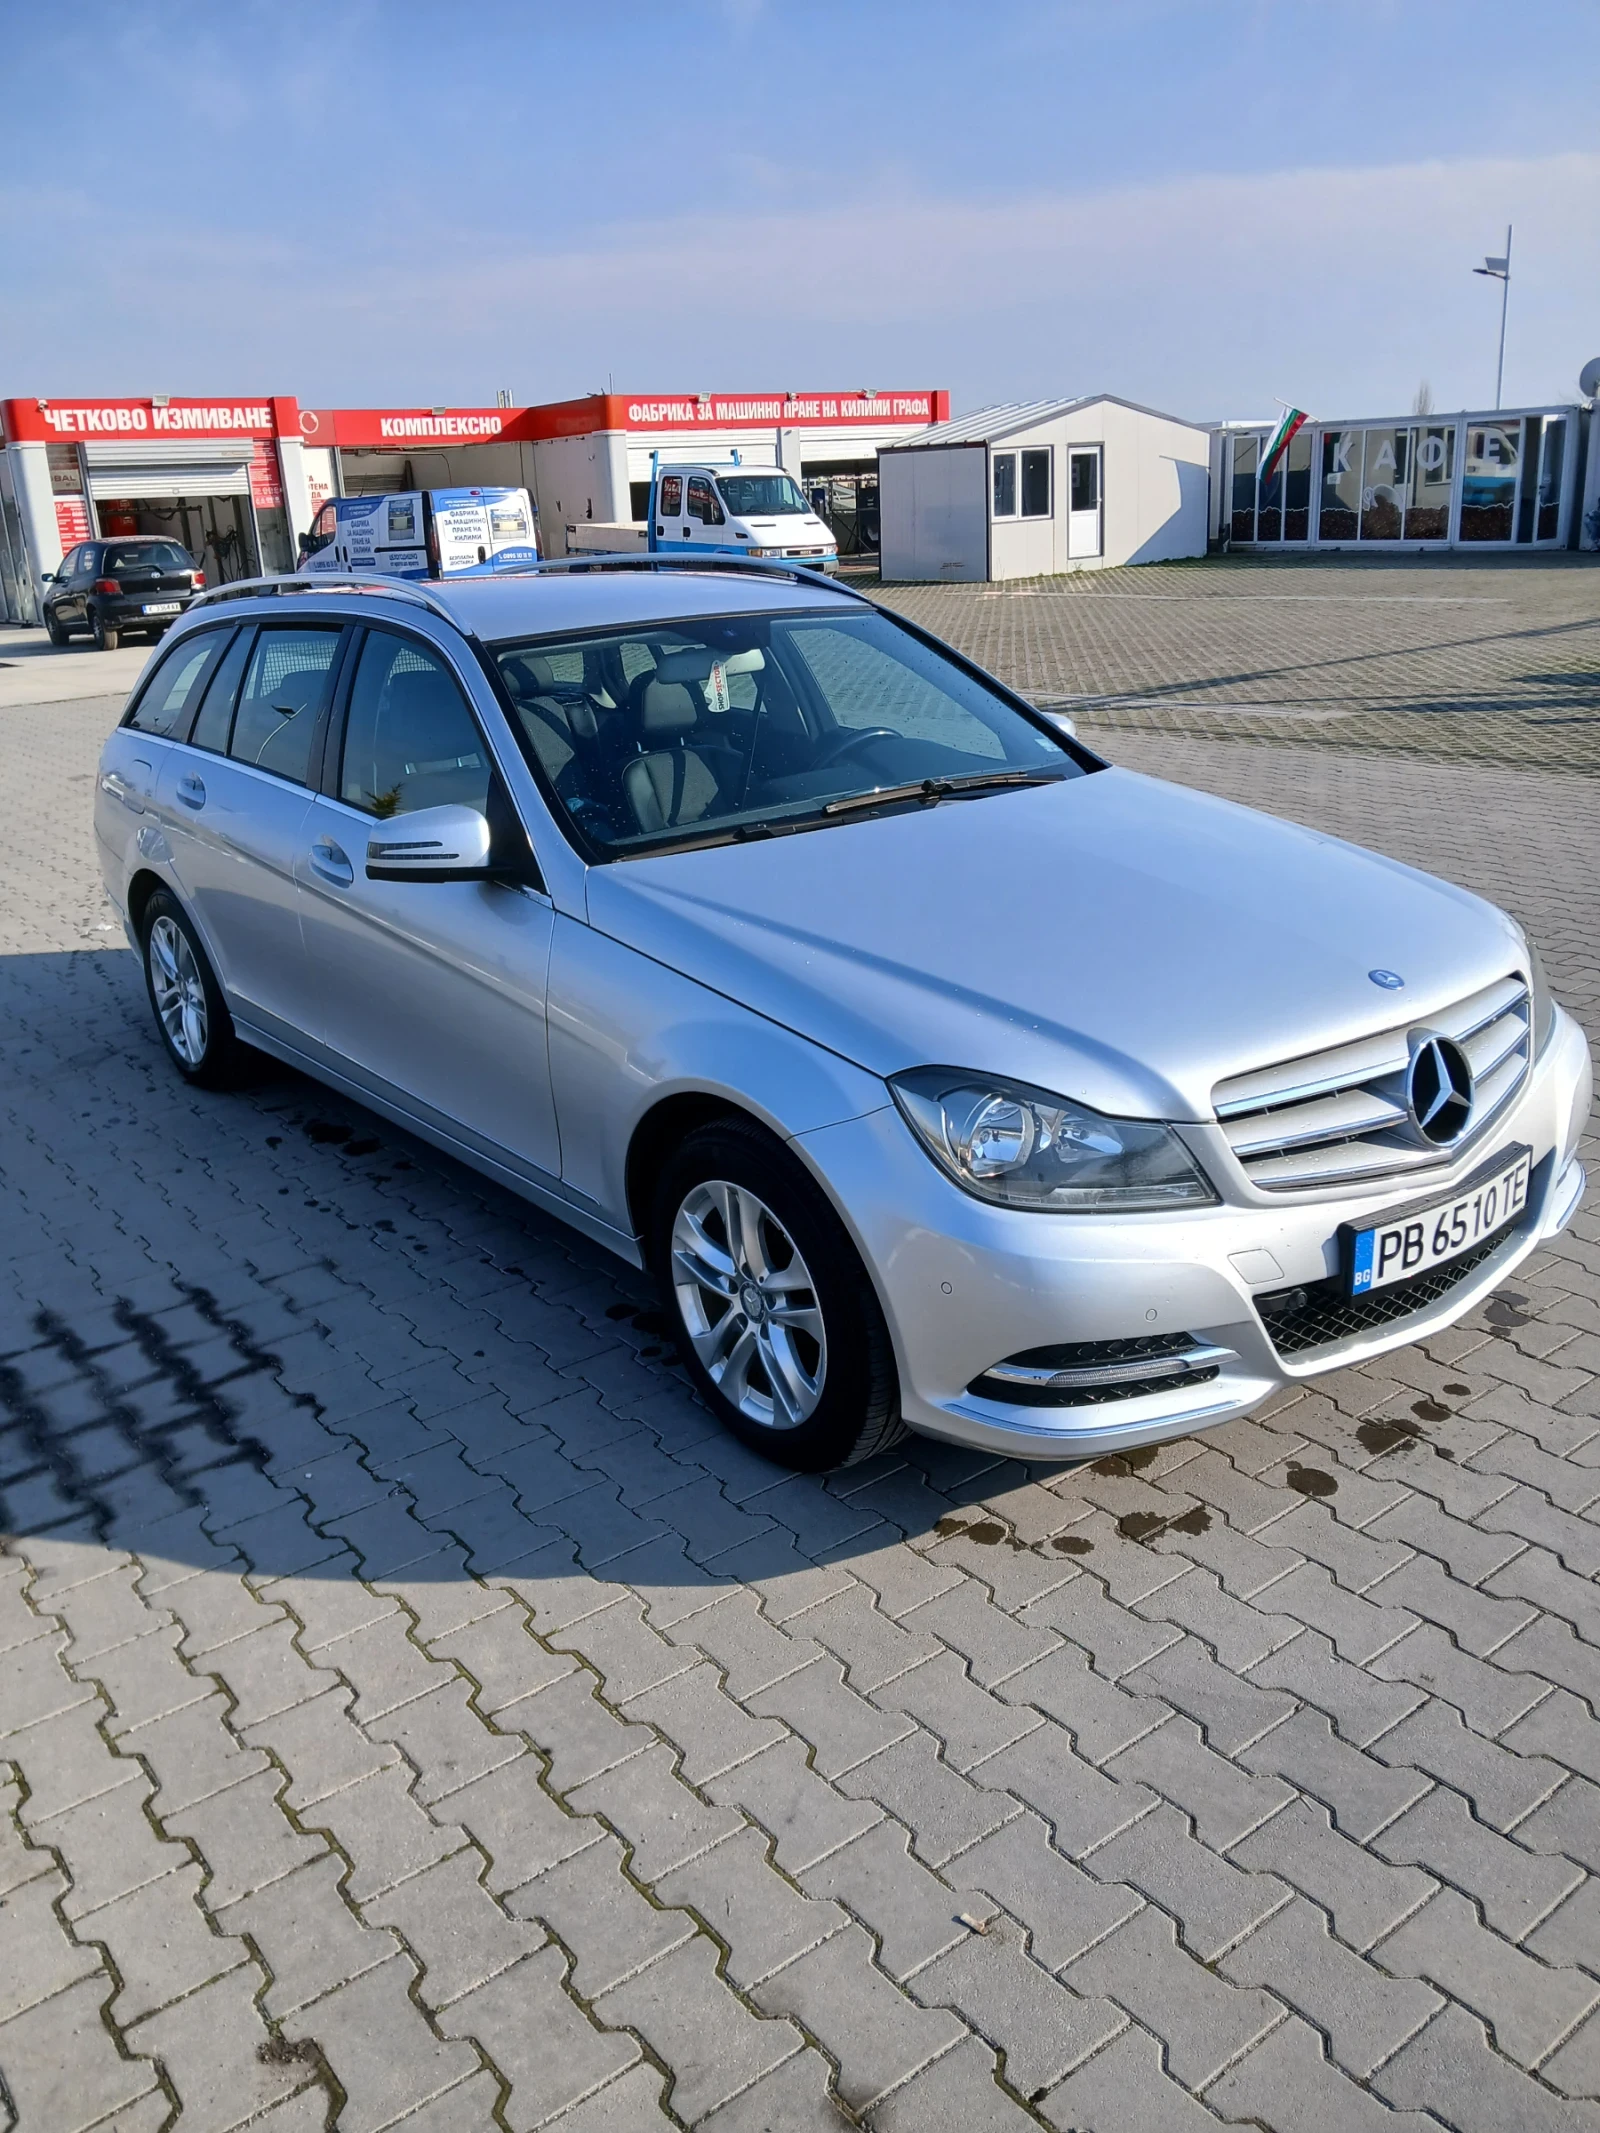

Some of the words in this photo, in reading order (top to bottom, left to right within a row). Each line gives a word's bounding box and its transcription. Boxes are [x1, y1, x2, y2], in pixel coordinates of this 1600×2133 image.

[44, 408, 147, 432] ЧЕТКОВО
[153, 406, 273, 430] ИЗМИВАНЕ
[628, 402, 694, 422] ФАБРИКА
[697, 402, 714, 421] ЗА
[716, 401, 781, 420] МАШИННО
[783, 400, 820, 418] ПРАНЕ
[822, 400, 838, 418] НА
[840, 399, 891, 417] КИЛИМИ
[893, 398, 929, 416] ГРАФА
[380, 416, 502, 437] КОМПЛЕКСНО
[308, 483, 328, 491] ТЕНА
[350, 520, 370, 528] ФАБРИКА
[453, 517, 486, 525] МАШИННО
[1377, 1222, 1424, 1279] PB
[1432, 1185, 1498, 1256] 6510
[1503, 1162, 1527, 1216] TE
[1354, 1269, 1371, 1286] BG
